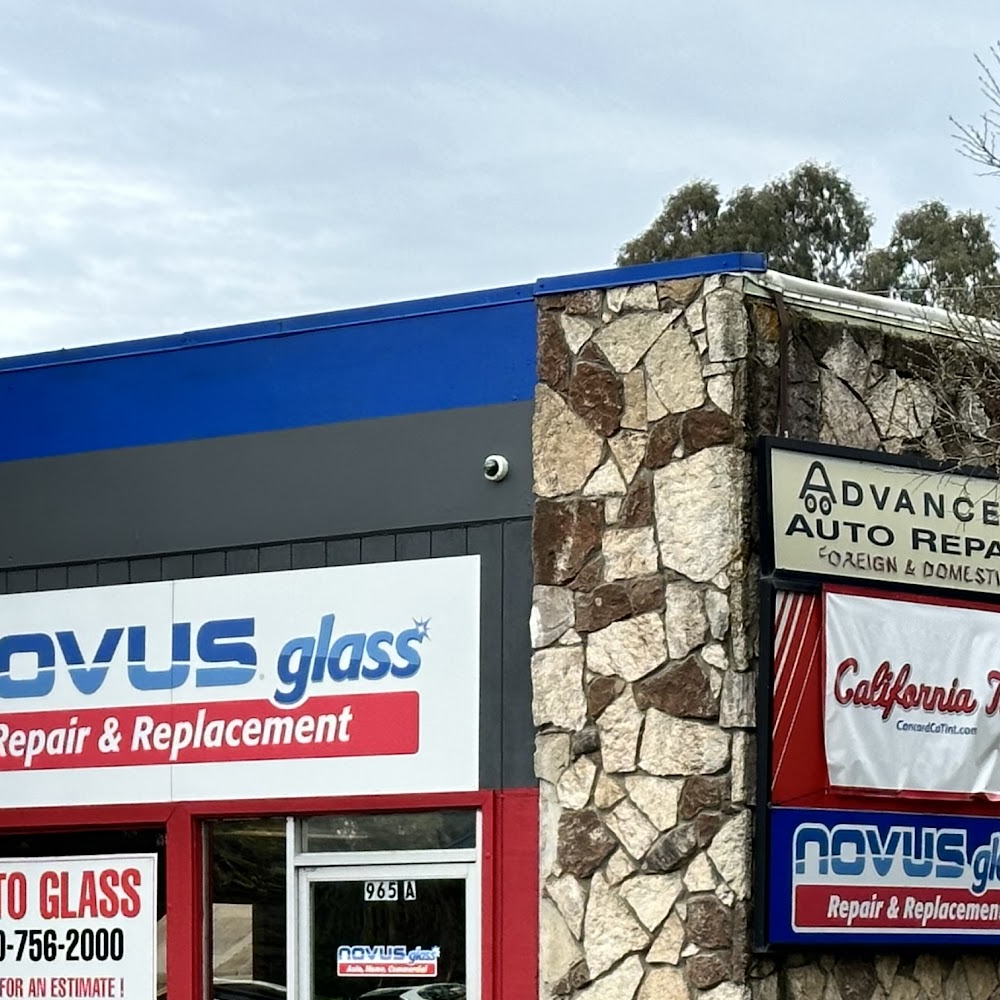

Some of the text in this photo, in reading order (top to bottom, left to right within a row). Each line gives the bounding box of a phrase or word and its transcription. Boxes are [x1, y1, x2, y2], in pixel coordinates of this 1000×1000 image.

[799, 461, 1000, 526] ADVANCE
[785, 514, 1000, 559] AUTO REPA
[905, 559, 916, 576] &
[273, 613, 423, 704] glass
[834, 657, 978, 721] California
[98, 717, 121, 753] &
[131, 705, 353, 761] Replacement
[972, 836, 1000, 894] gl
[39, 868, 142, 920] GLASS
[366, 881, 415, 899] 965 A
[827, 894, 884, 926] Repair
[887, 897, 899, 919] &
[408, 946, 436, 963] glass
[0, 977, 23, 998] FOR
[28, 977, 46, 998] AN
[51, 977, 116, 998] ESTIMATE
